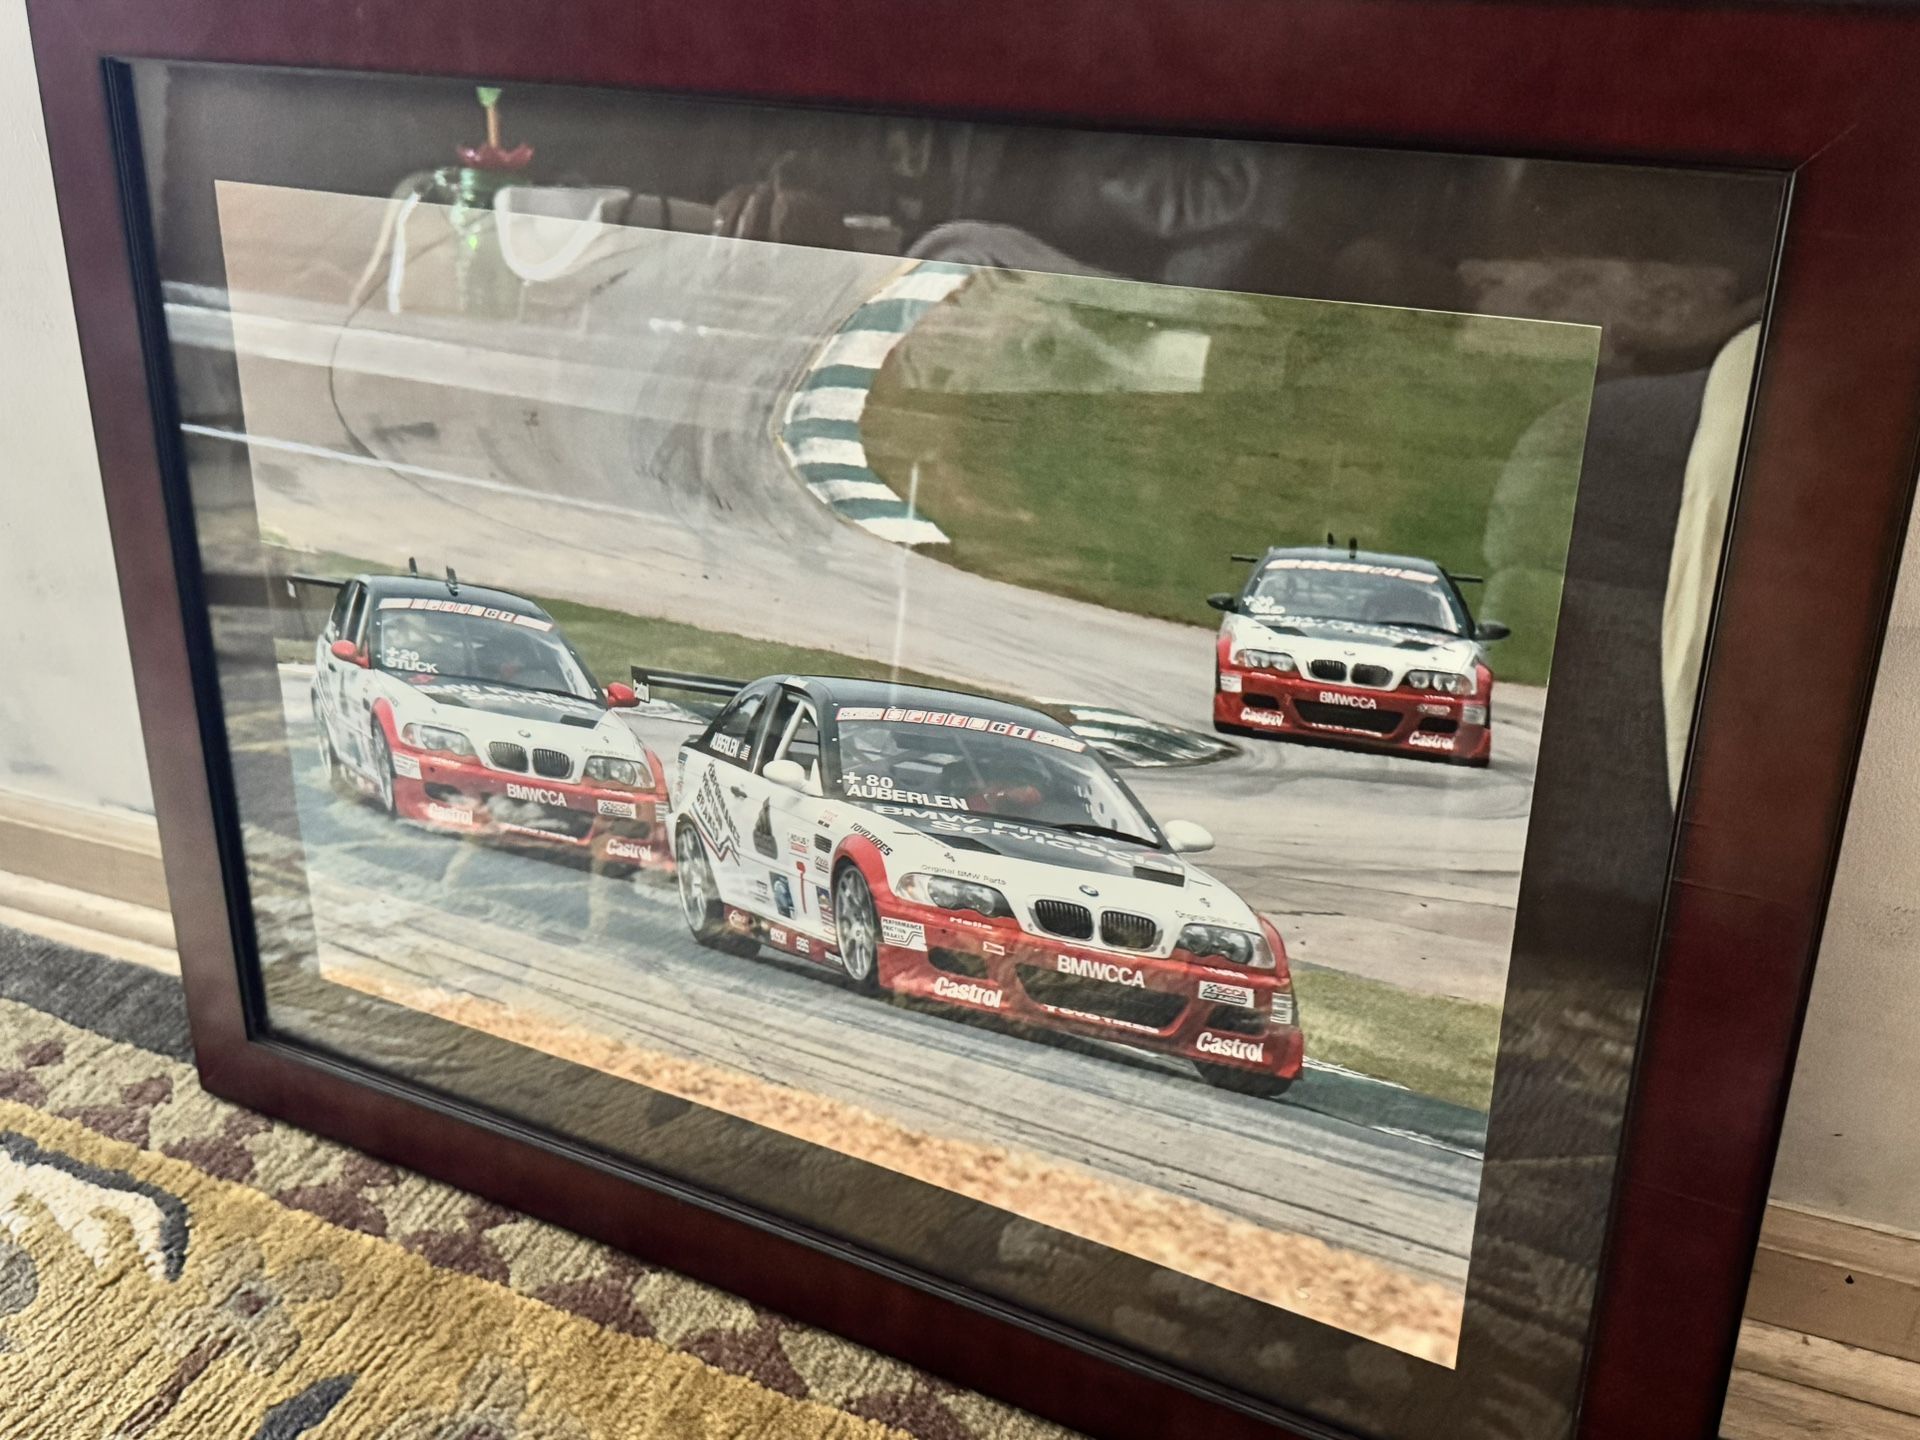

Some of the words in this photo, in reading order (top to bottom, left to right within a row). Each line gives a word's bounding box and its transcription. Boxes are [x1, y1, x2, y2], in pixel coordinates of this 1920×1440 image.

[385, 657, 440, 674] STUCK
[1319, 691, 1377, 710] BMWCCA
[866, 774, 894, 789] 80
[506, 783, 567, 807] BMWCCA
[846, 784, 970, 811] AUBERLEN
[872, 805, 981, 824] BMW
[605, 838, 652, 861] Castrol
[1057, 954, 1146, 989] BMWCCA
[933, 976, 1003, 1009] Castrol
[1196, 1031, 1264, 1063] Castrol
